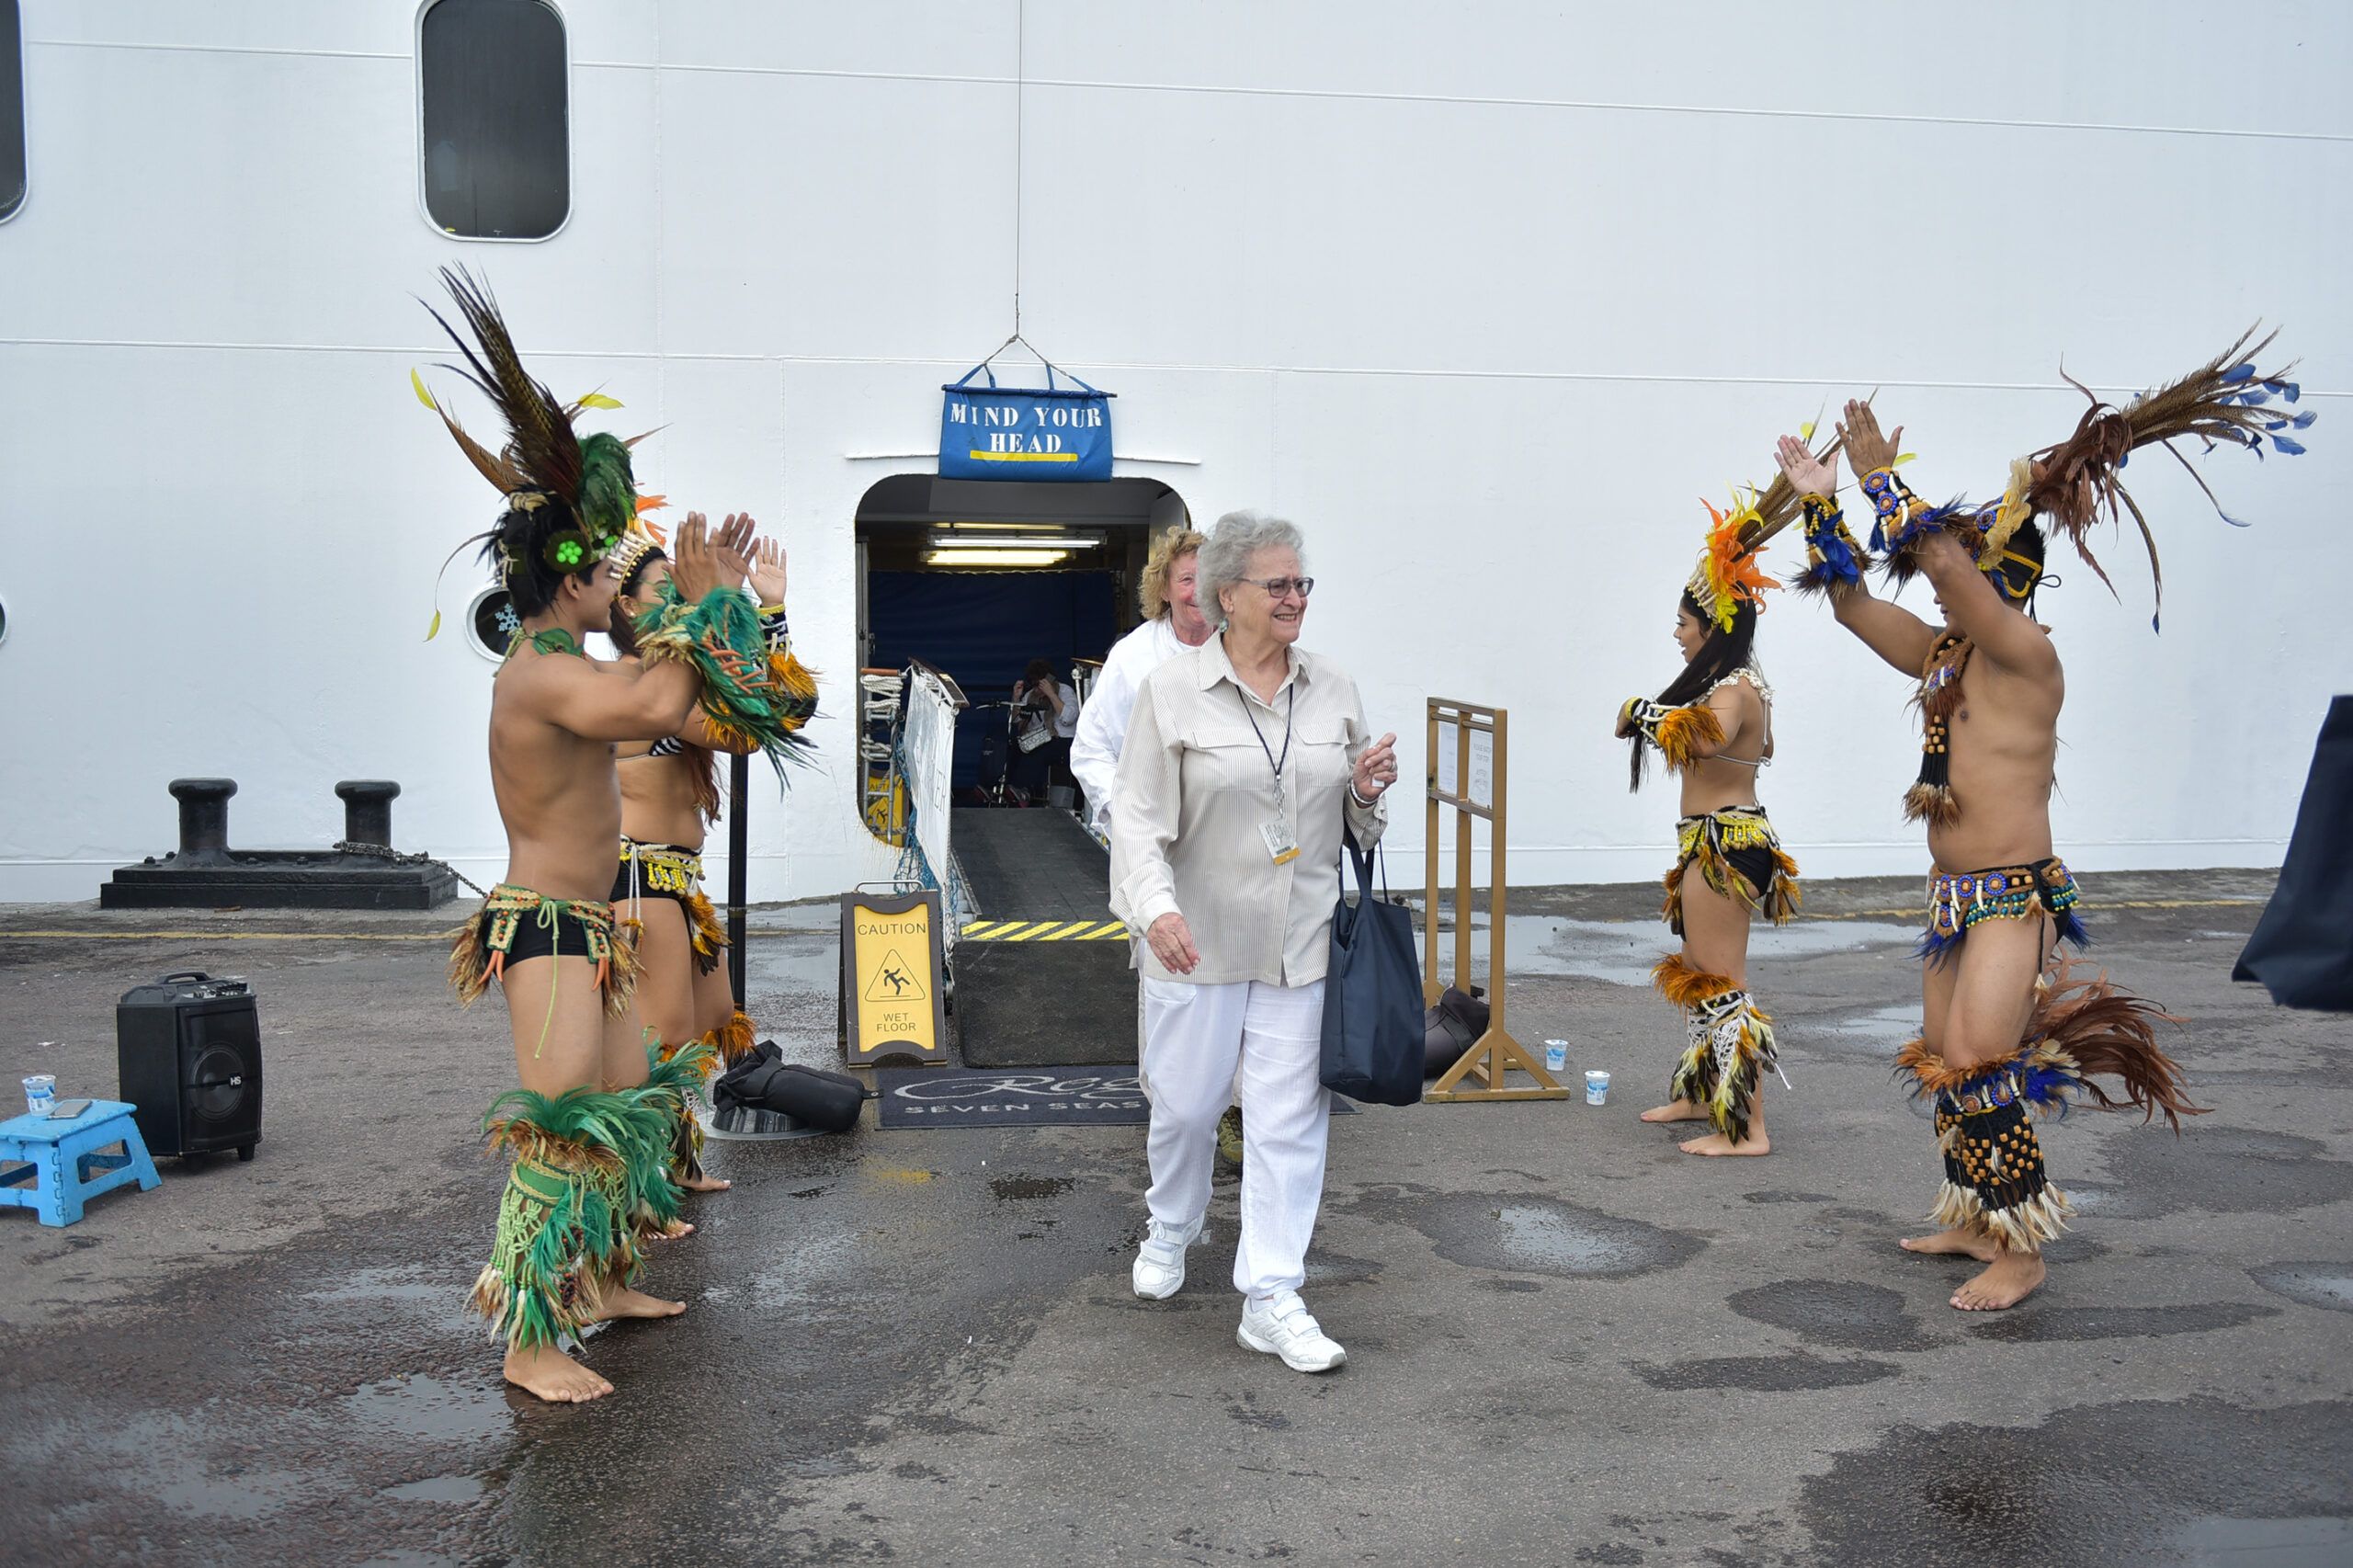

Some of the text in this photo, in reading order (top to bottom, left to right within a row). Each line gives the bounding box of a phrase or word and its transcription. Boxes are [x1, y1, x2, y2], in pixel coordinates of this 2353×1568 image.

[949, 403, 1102, 428] MIND YOUR
[990, 433, 1062, 453] HEAD
[858, 923, 926, 936] CAUTION
[883, 1012, 909, 1022] WET
[876, 1022, 916, 1032] FLOOR
[230, 1075, 242, 1086] HS
[894, 1075, 1150, 1100] Reg
[904, 1100, 1141, 1114] SEVEN SEAS
